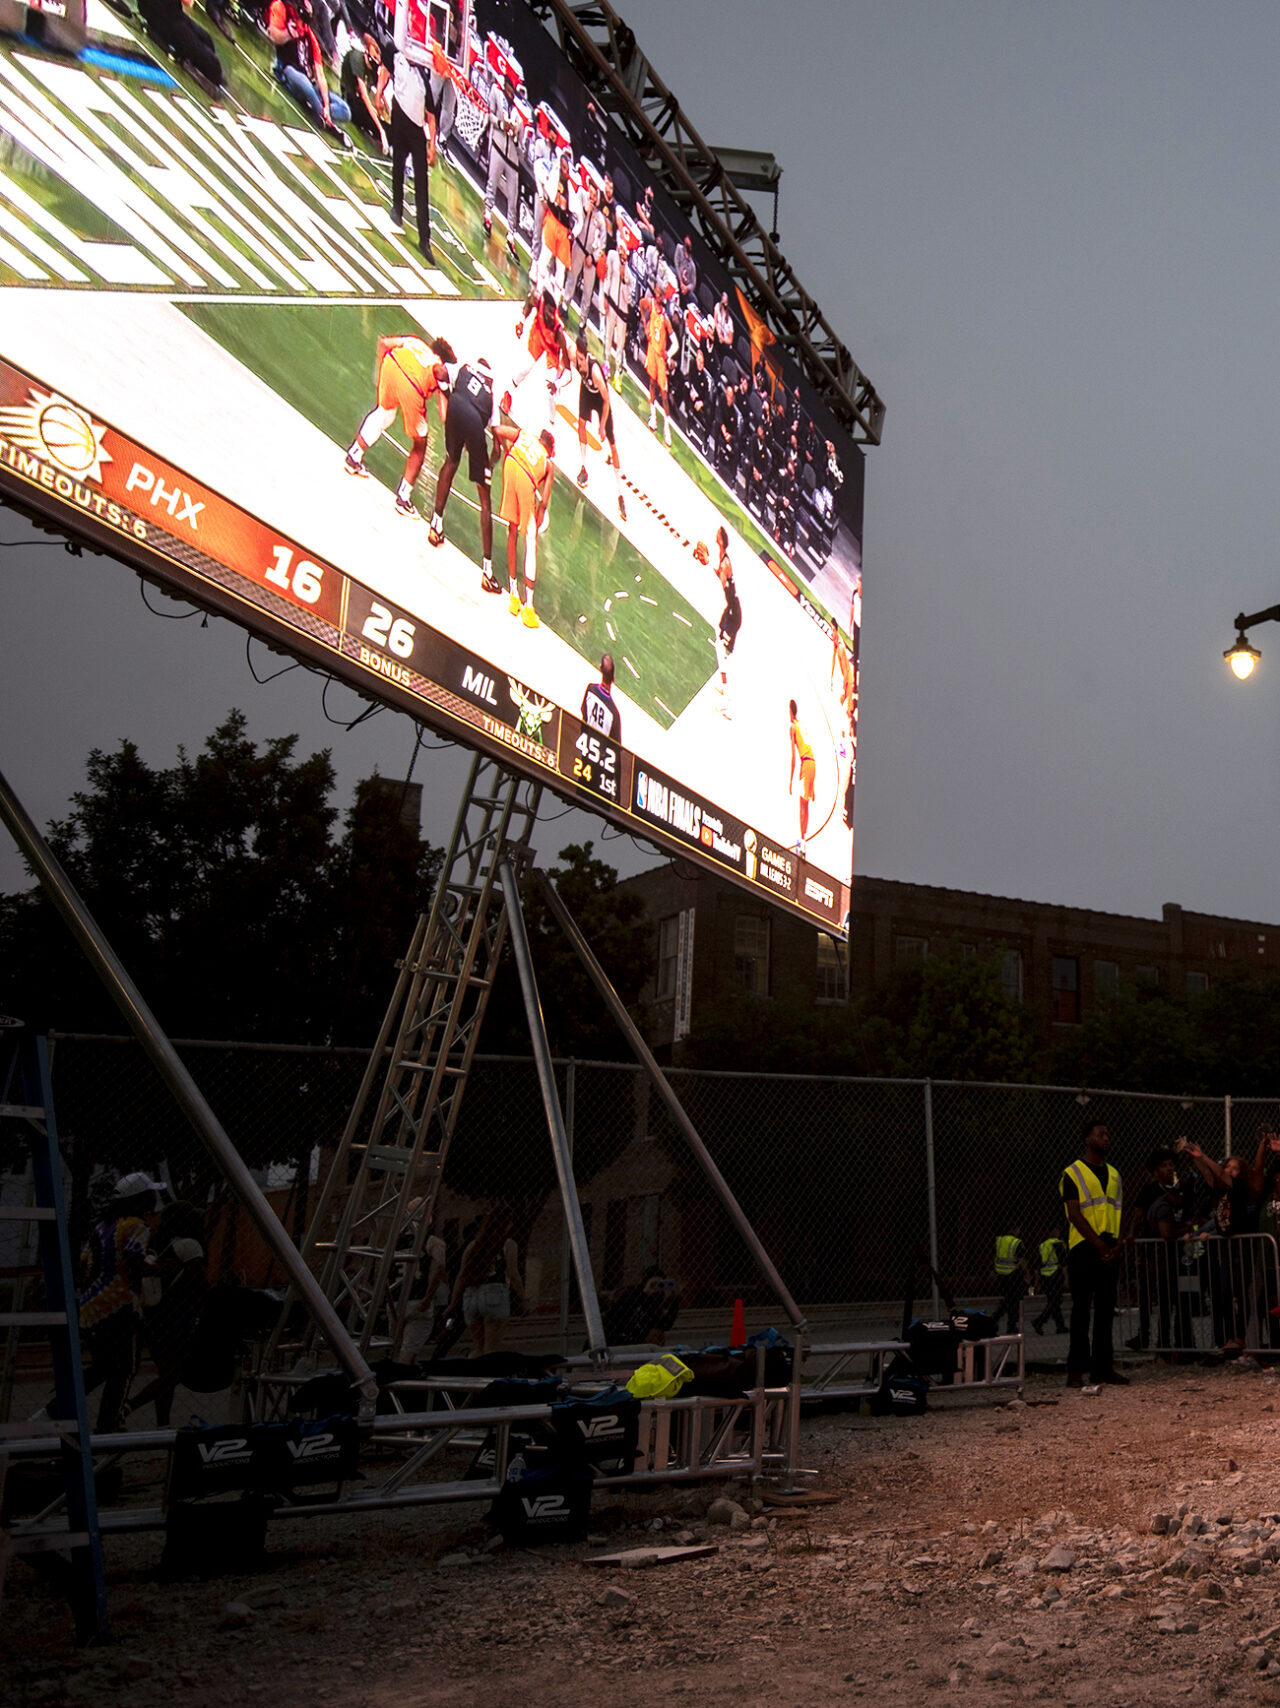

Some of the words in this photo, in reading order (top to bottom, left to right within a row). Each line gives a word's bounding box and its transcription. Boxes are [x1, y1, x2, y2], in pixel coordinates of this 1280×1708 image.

[125, 462, 205, 530] PHX
[264, 545, 323, 604] 16
[360, 602, 416, 659] 26
[359, 646, 411, 687] BONUS
[462, 665, 497, 706] MIL
[575, 732, 616, 774] 45.2
[573, 758, 592, 782] 24
[599, 773, 616, 796] 1st
[647, 777, 669, 822] NBA
[669, 790, 701, 839] FINALS
[761, 847, 786, 871] GAME
[785, 861, 792, 875] 6
[804, 877, 834, 908] ESPN
[287, 1433, 342, 1458] V2
[576, 1414, 626, 1438] V2
[197, 1438, 254, 1464] V2
[521, 1495, 571, 1518] V2
